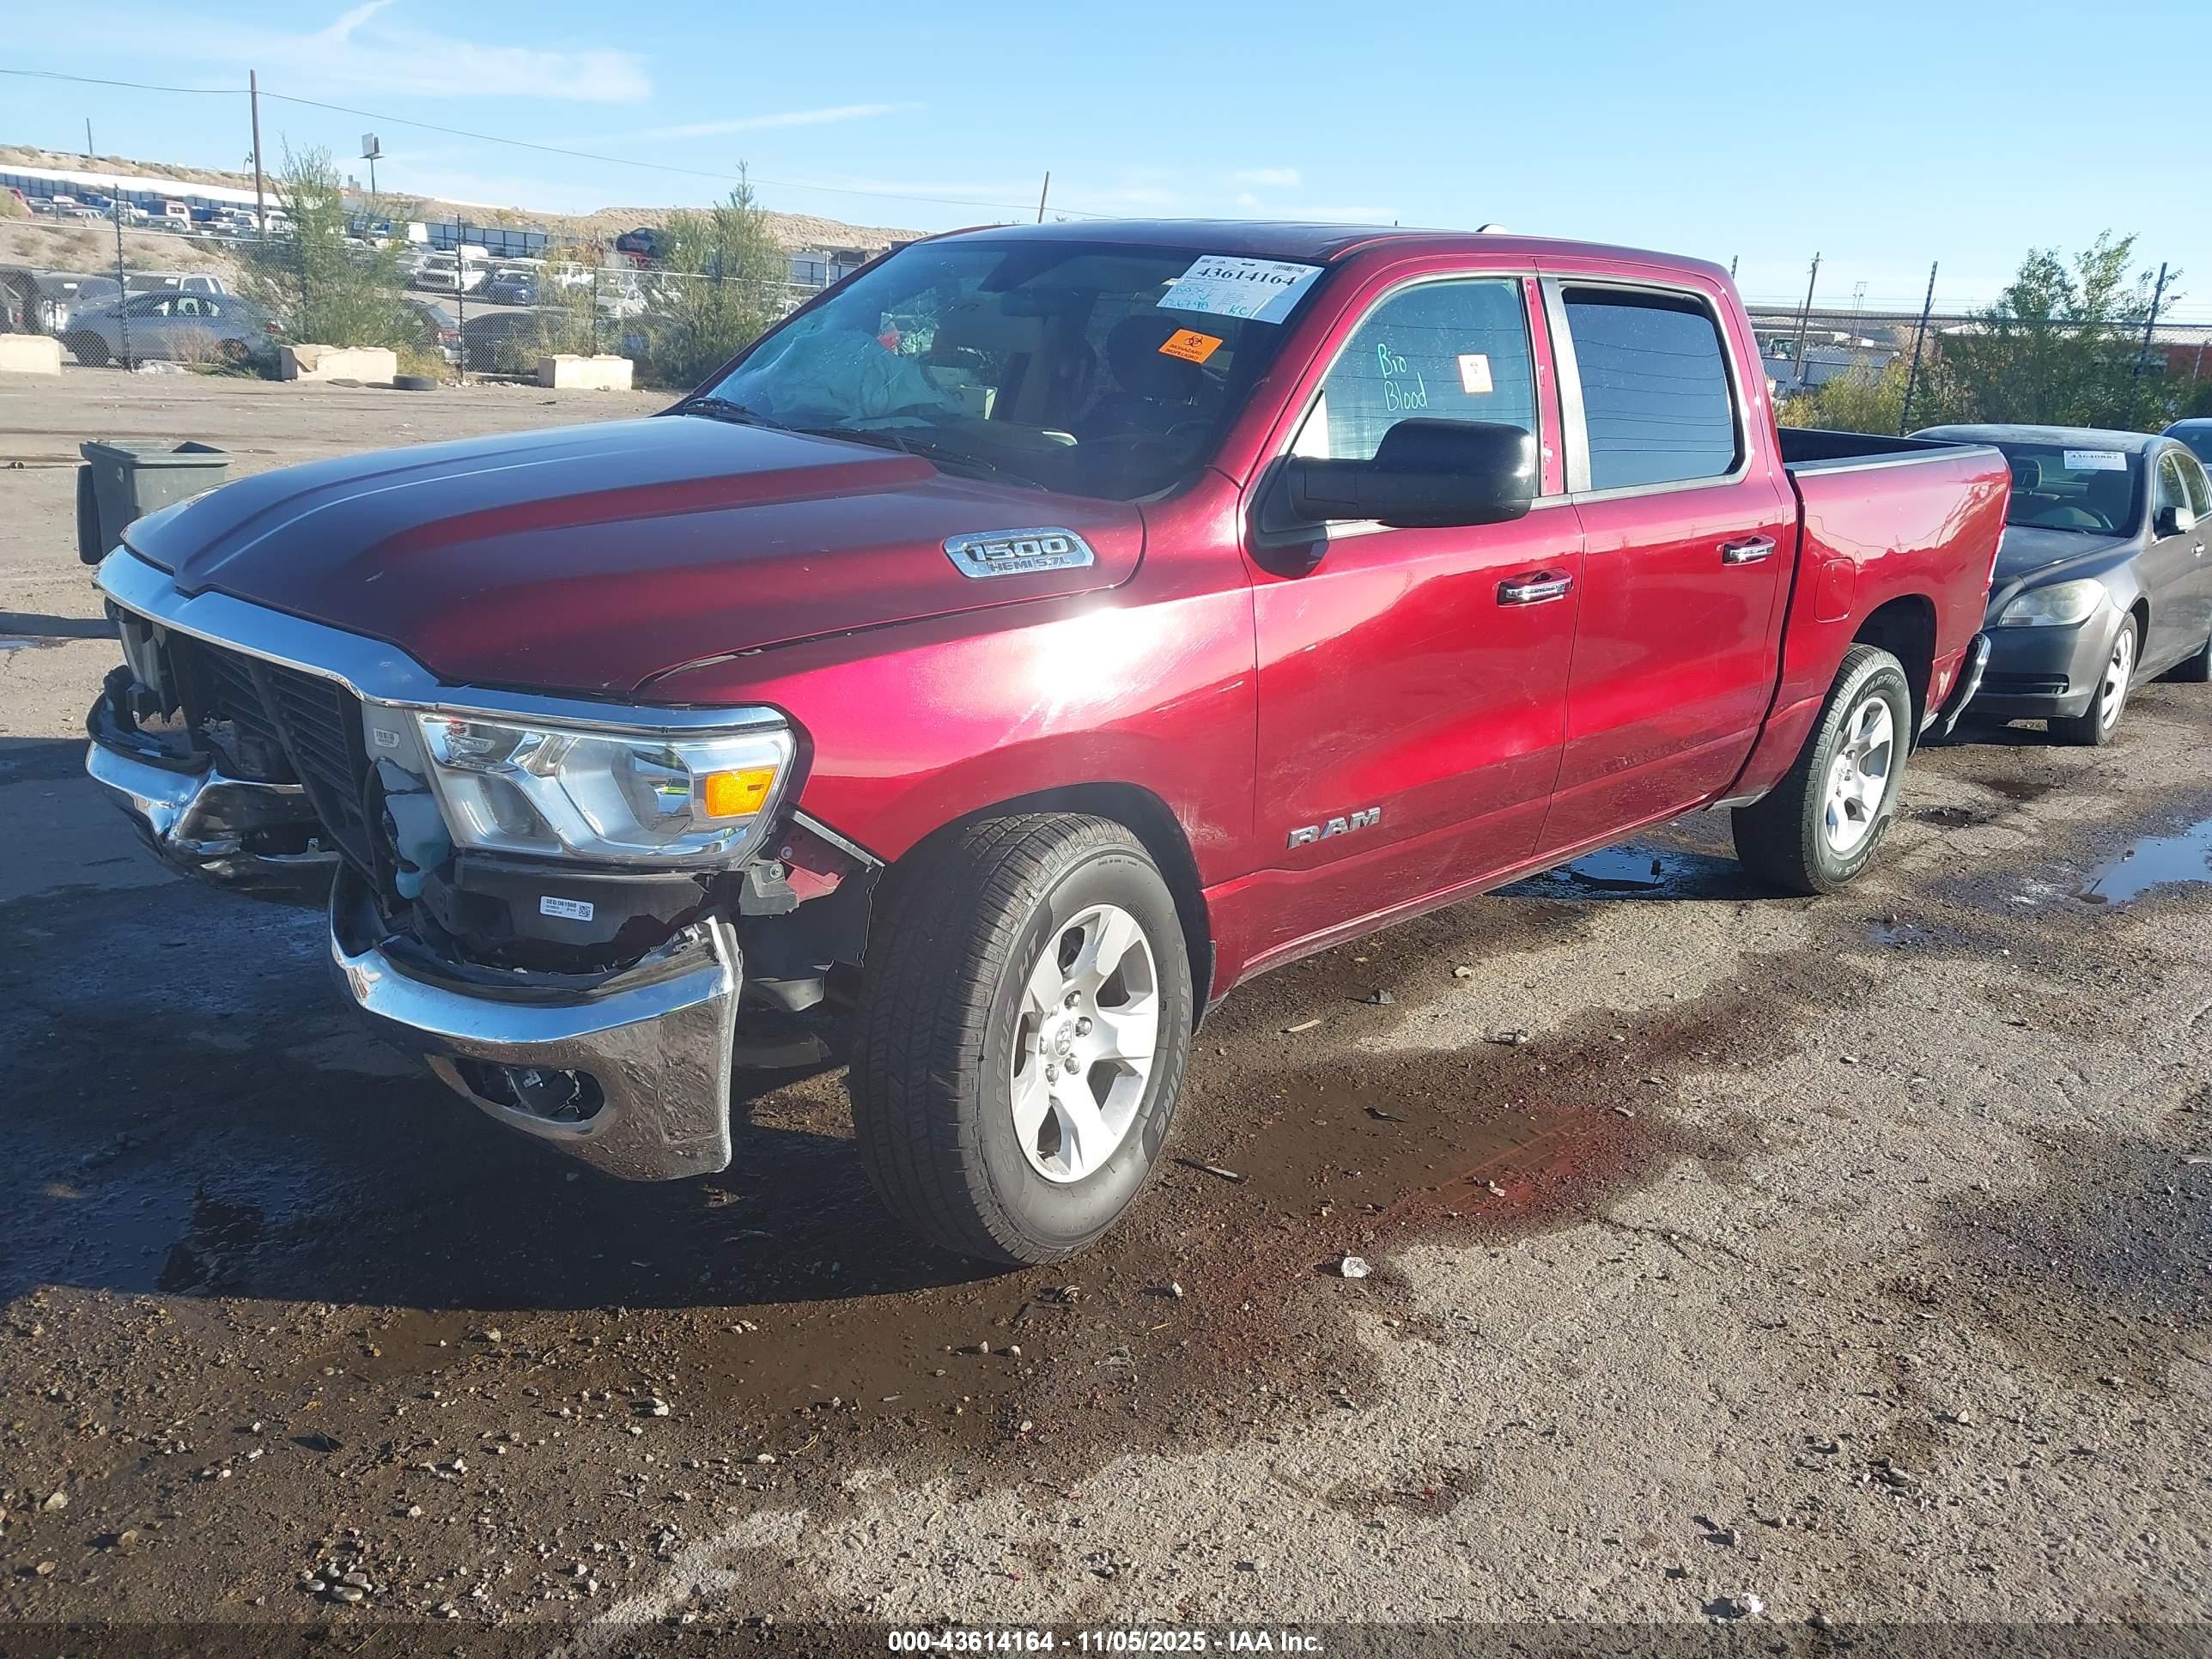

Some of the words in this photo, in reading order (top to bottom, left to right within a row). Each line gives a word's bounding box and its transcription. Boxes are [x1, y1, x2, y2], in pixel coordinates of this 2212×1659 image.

[1196, 266, 1297, 287] 43614164
[1377, 343, 1407, 379] Bio
[1384, 371, 1429, 412] Blood
[965, 537, 1069, 562] 1500
[987, 559, 1034, 573] HEMI
[1035, 556, 1073, 568] 5.7L
[1285, 806, 1382, 850] RAM
[1018, 929, 1039, 984] HT
[1154, 958, 1189, 1140] STARFIRE
